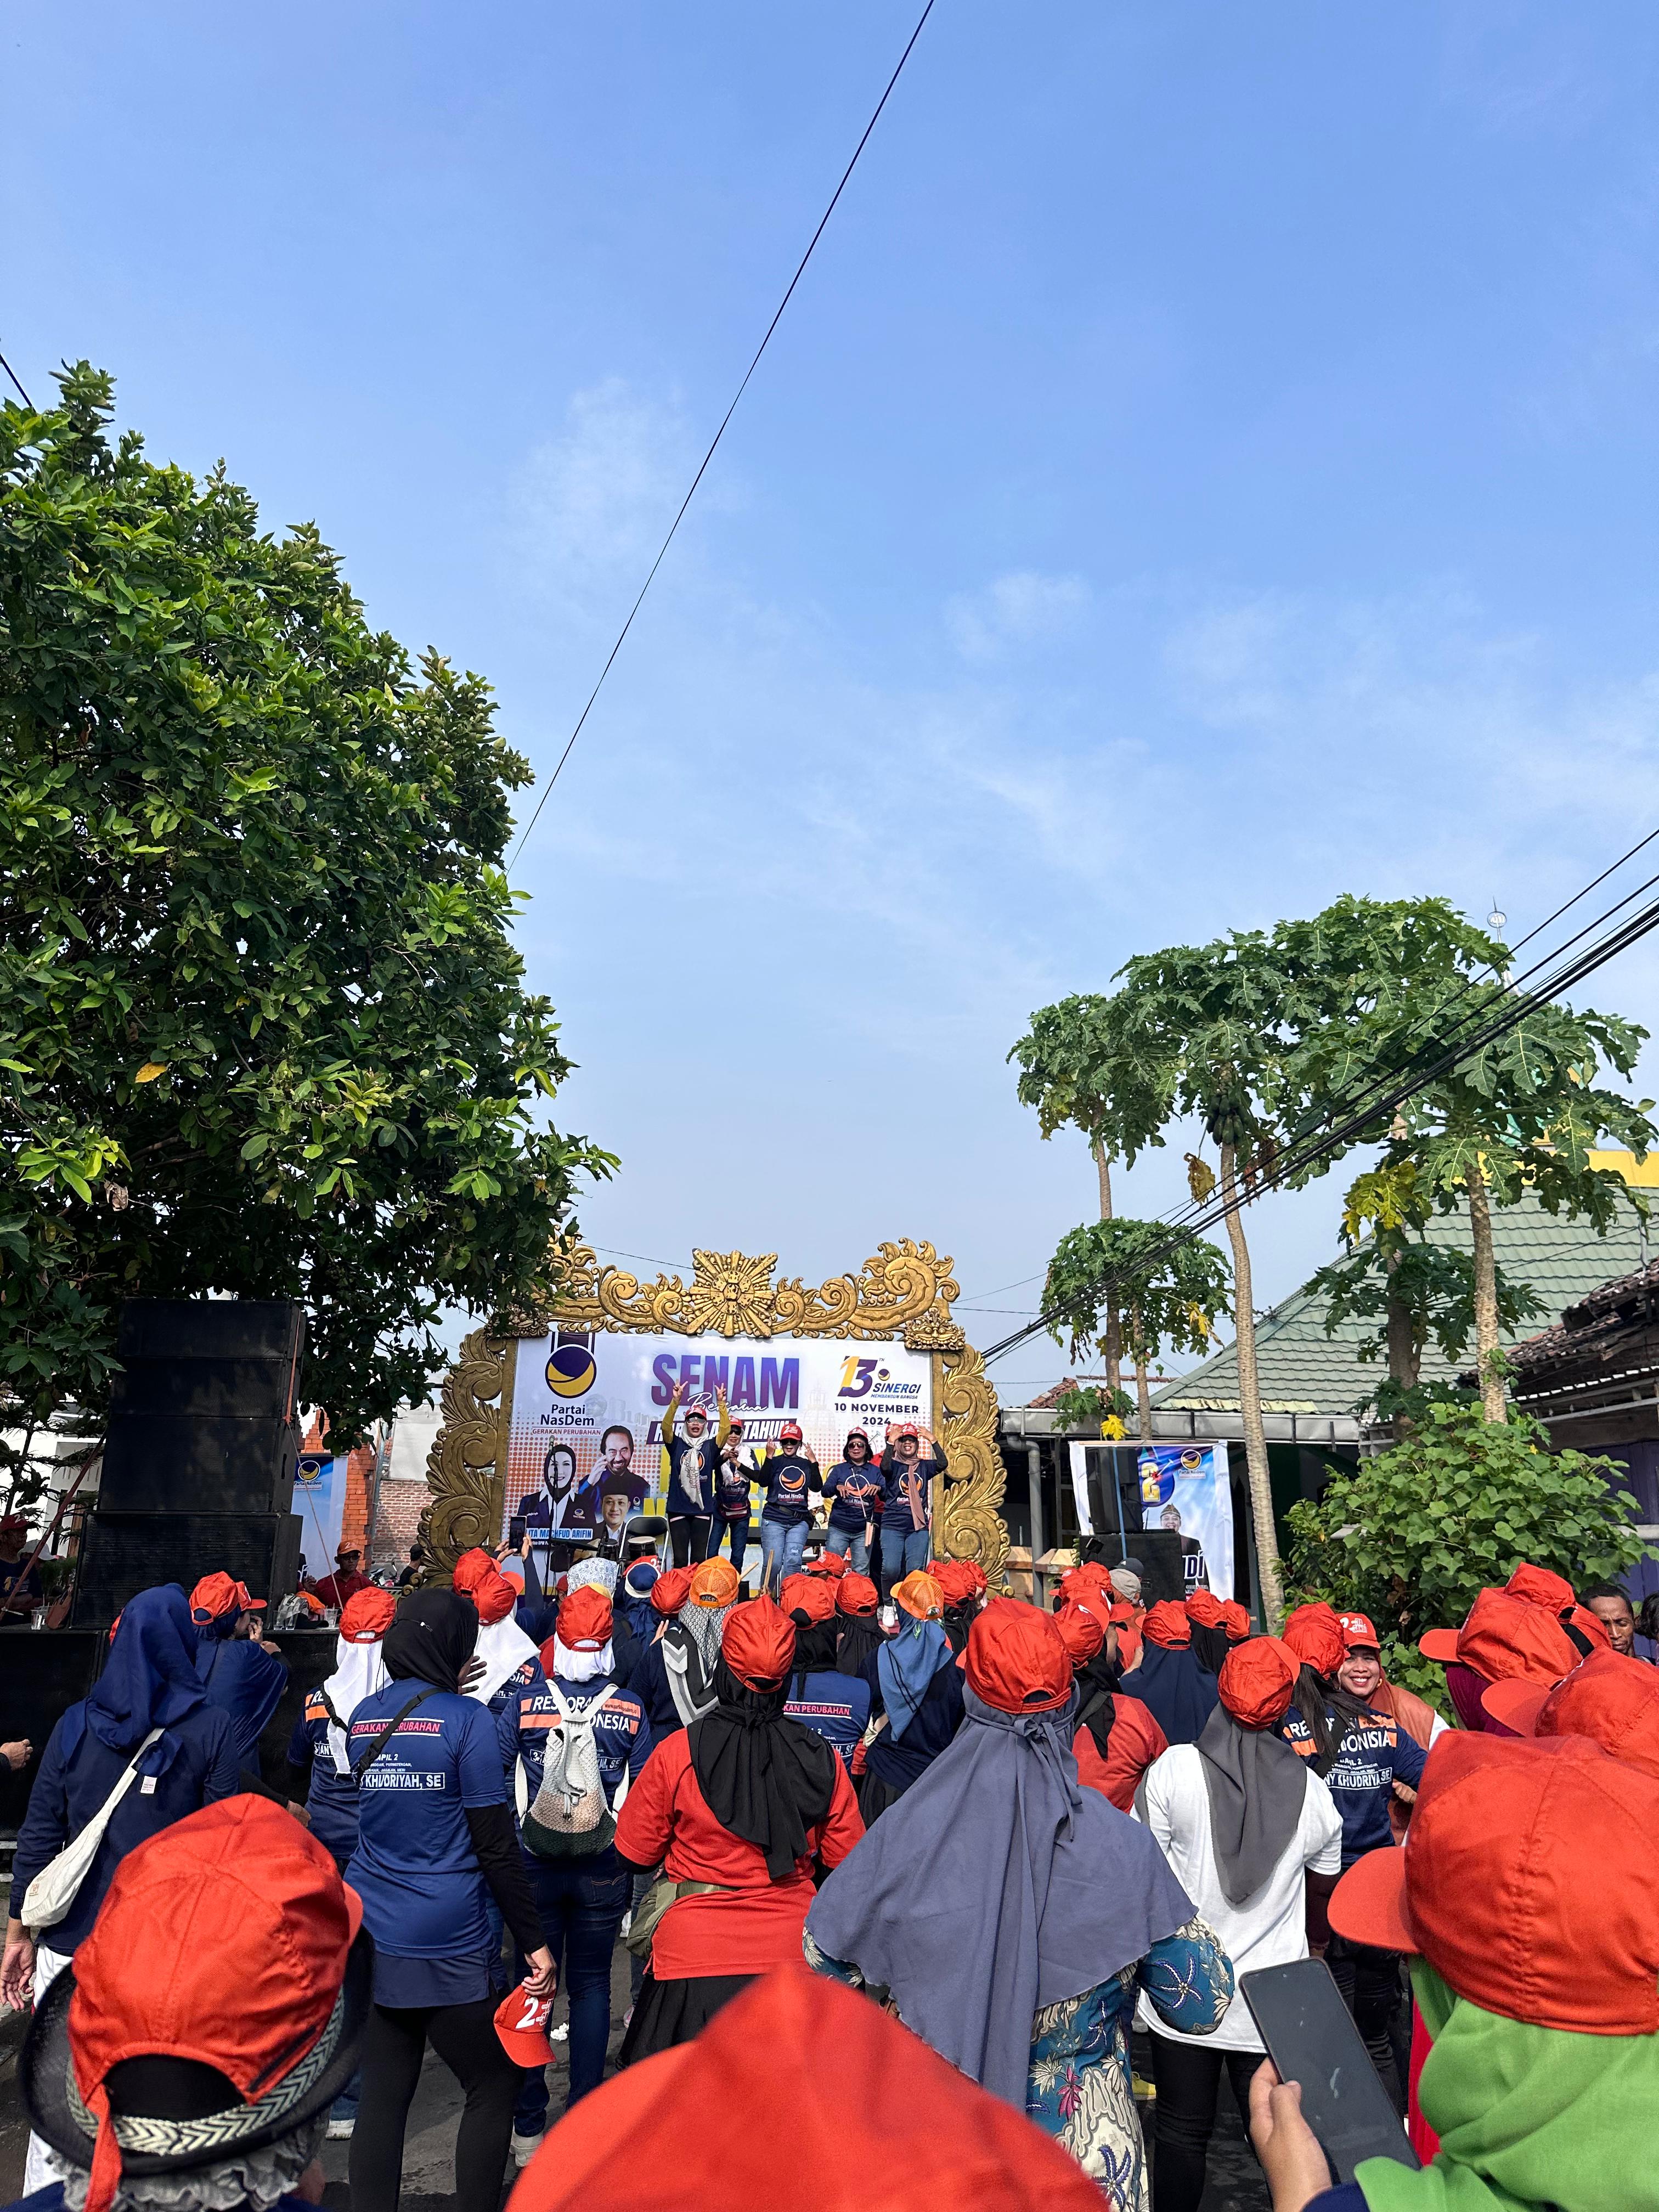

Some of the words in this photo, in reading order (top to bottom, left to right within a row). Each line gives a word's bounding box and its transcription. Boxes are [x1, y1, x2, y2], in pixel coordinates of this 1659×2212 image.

[651, 1354, 799, 1409] SENAM
[837, 1356, 878, 1398] 13
[873, 1383, 921, 1393] SINERGI
[551, 1404, 585, 1414] Partai
[834, 1403, 847, 1411] 10
[851, 1403, 919, 1413] NOVEMBER
[540, 1414, 594, 1426] NasDem
[862, 1417, 891, 1425] 2024
[572, 1530, 591, 1538] ARIFIN
[802, 1705, 849, 1715] PERUBAHAN
[426, 1775, 441, 1787] SE
[516, 1996, 539, 2029] 2
